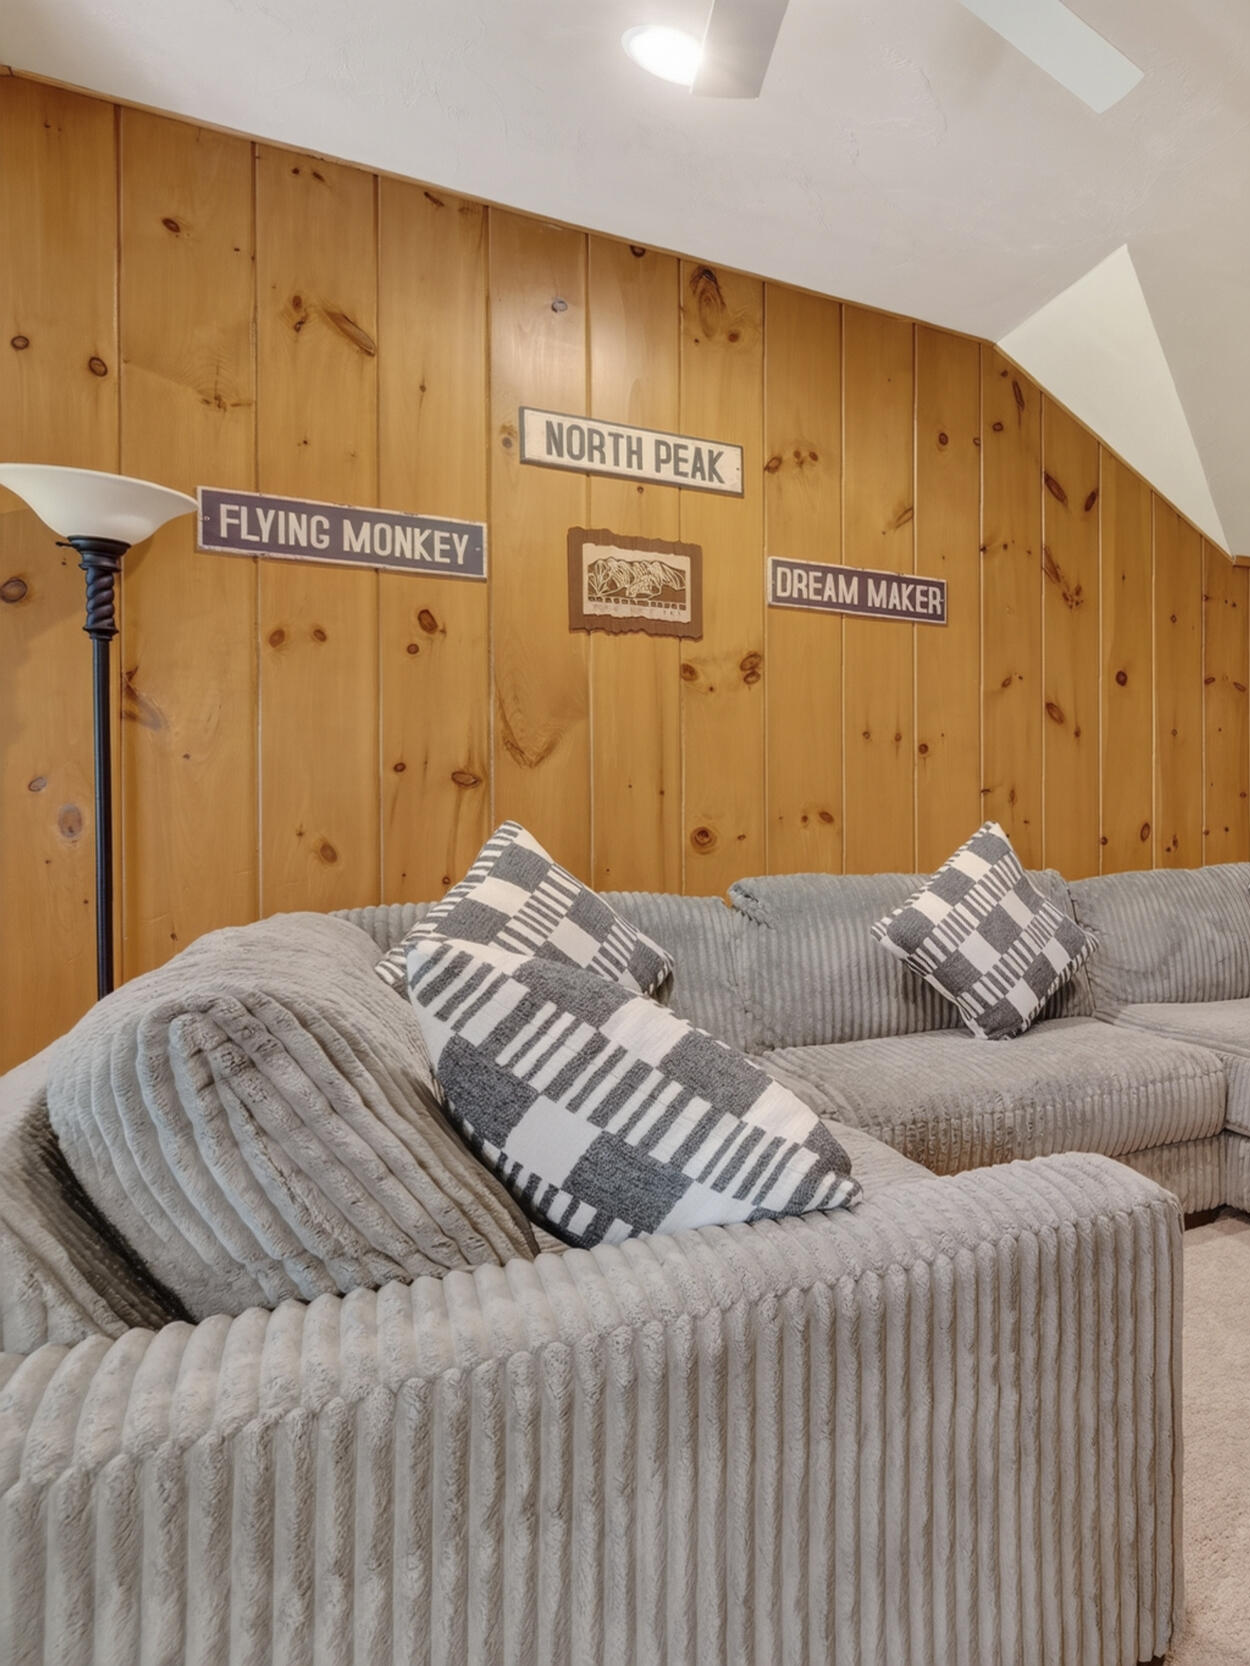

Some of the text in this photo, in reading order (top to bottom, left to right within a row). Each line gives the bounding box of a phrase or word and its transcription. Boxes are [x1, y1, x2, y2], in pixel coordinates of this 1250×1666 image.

[545, 420, 725, 484] NORTH PEAK
[219, 503, 469, 565] FLYING MONKEY
[776, 566, 942, 615] DREAM MAKER
